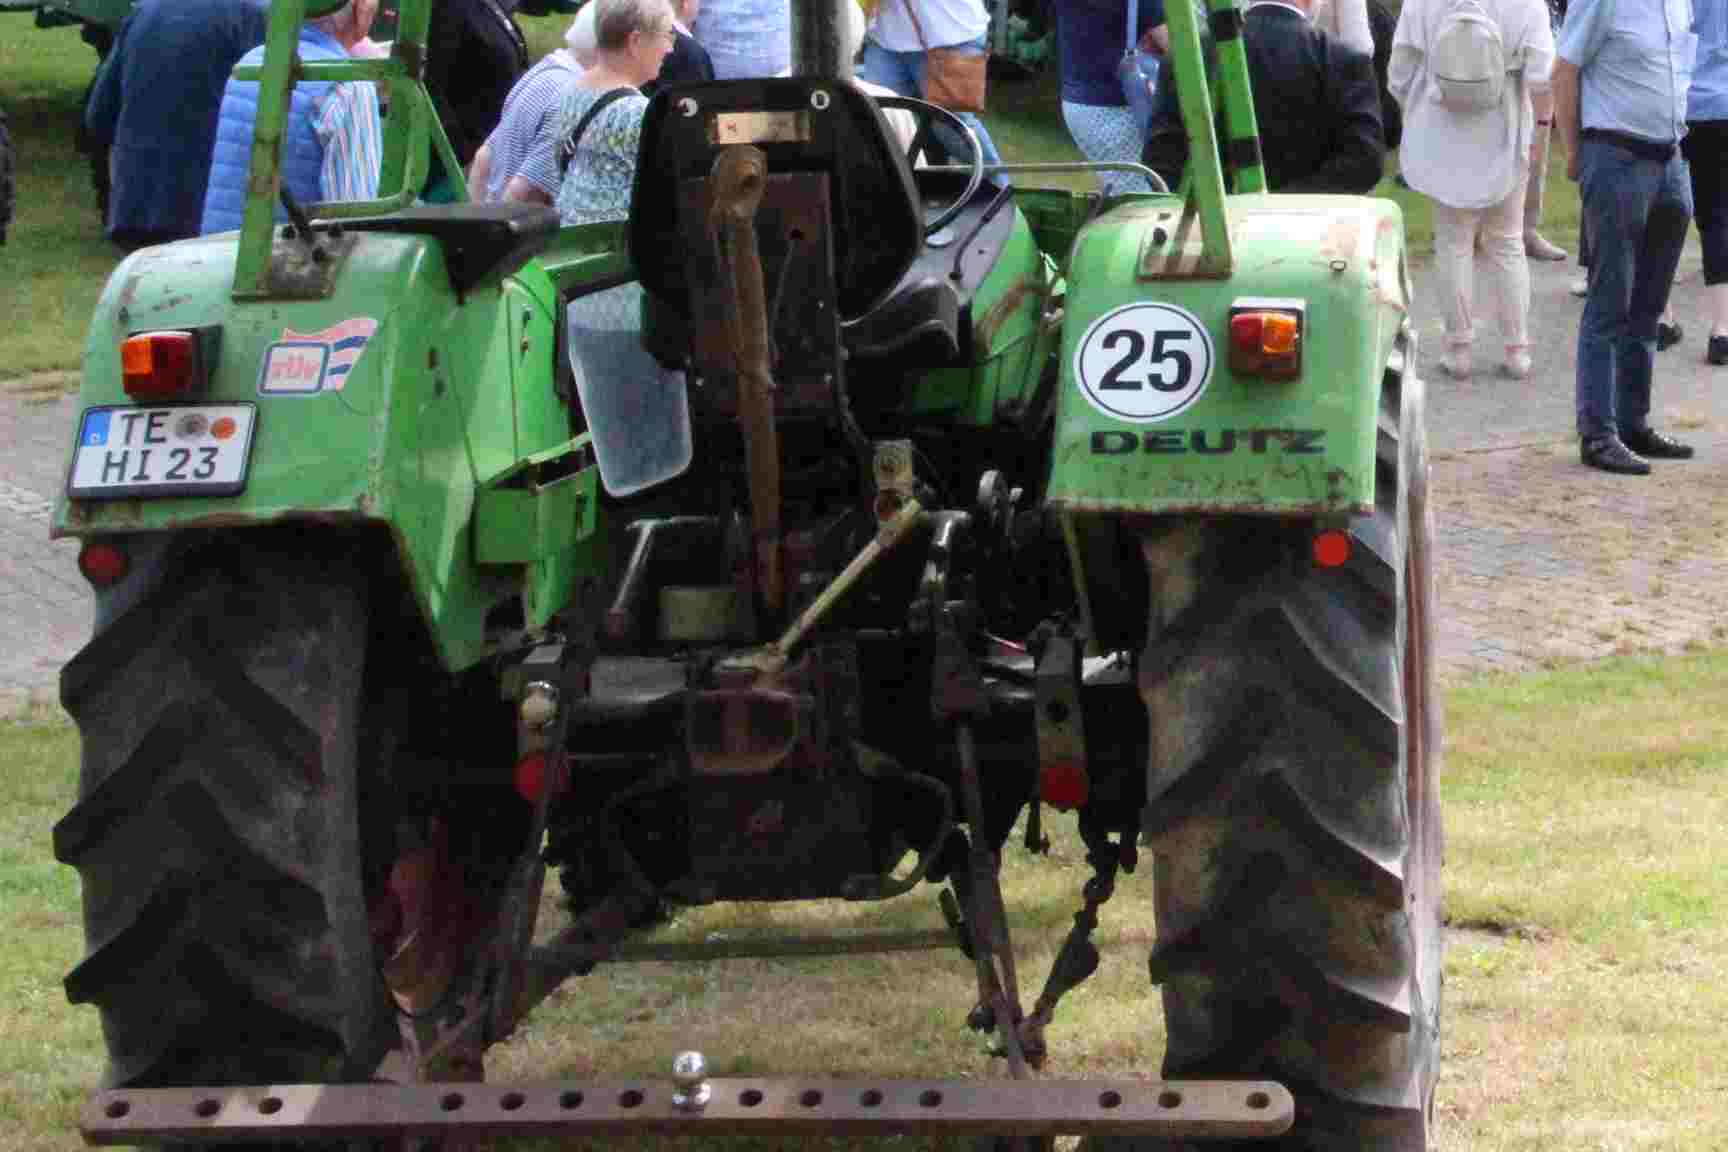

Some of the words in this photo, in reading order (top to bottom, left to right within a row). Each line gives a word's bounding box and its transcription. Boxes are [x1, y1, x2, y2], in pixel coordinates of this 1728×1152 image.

[1098, 329, 1193, 392] 25
[121, 411, 170, 446] TE
[1090, 429, 1327, 455] DEUTZ
[102, 448, 152, 483] HI
[165, 447, 219, 481] 23
